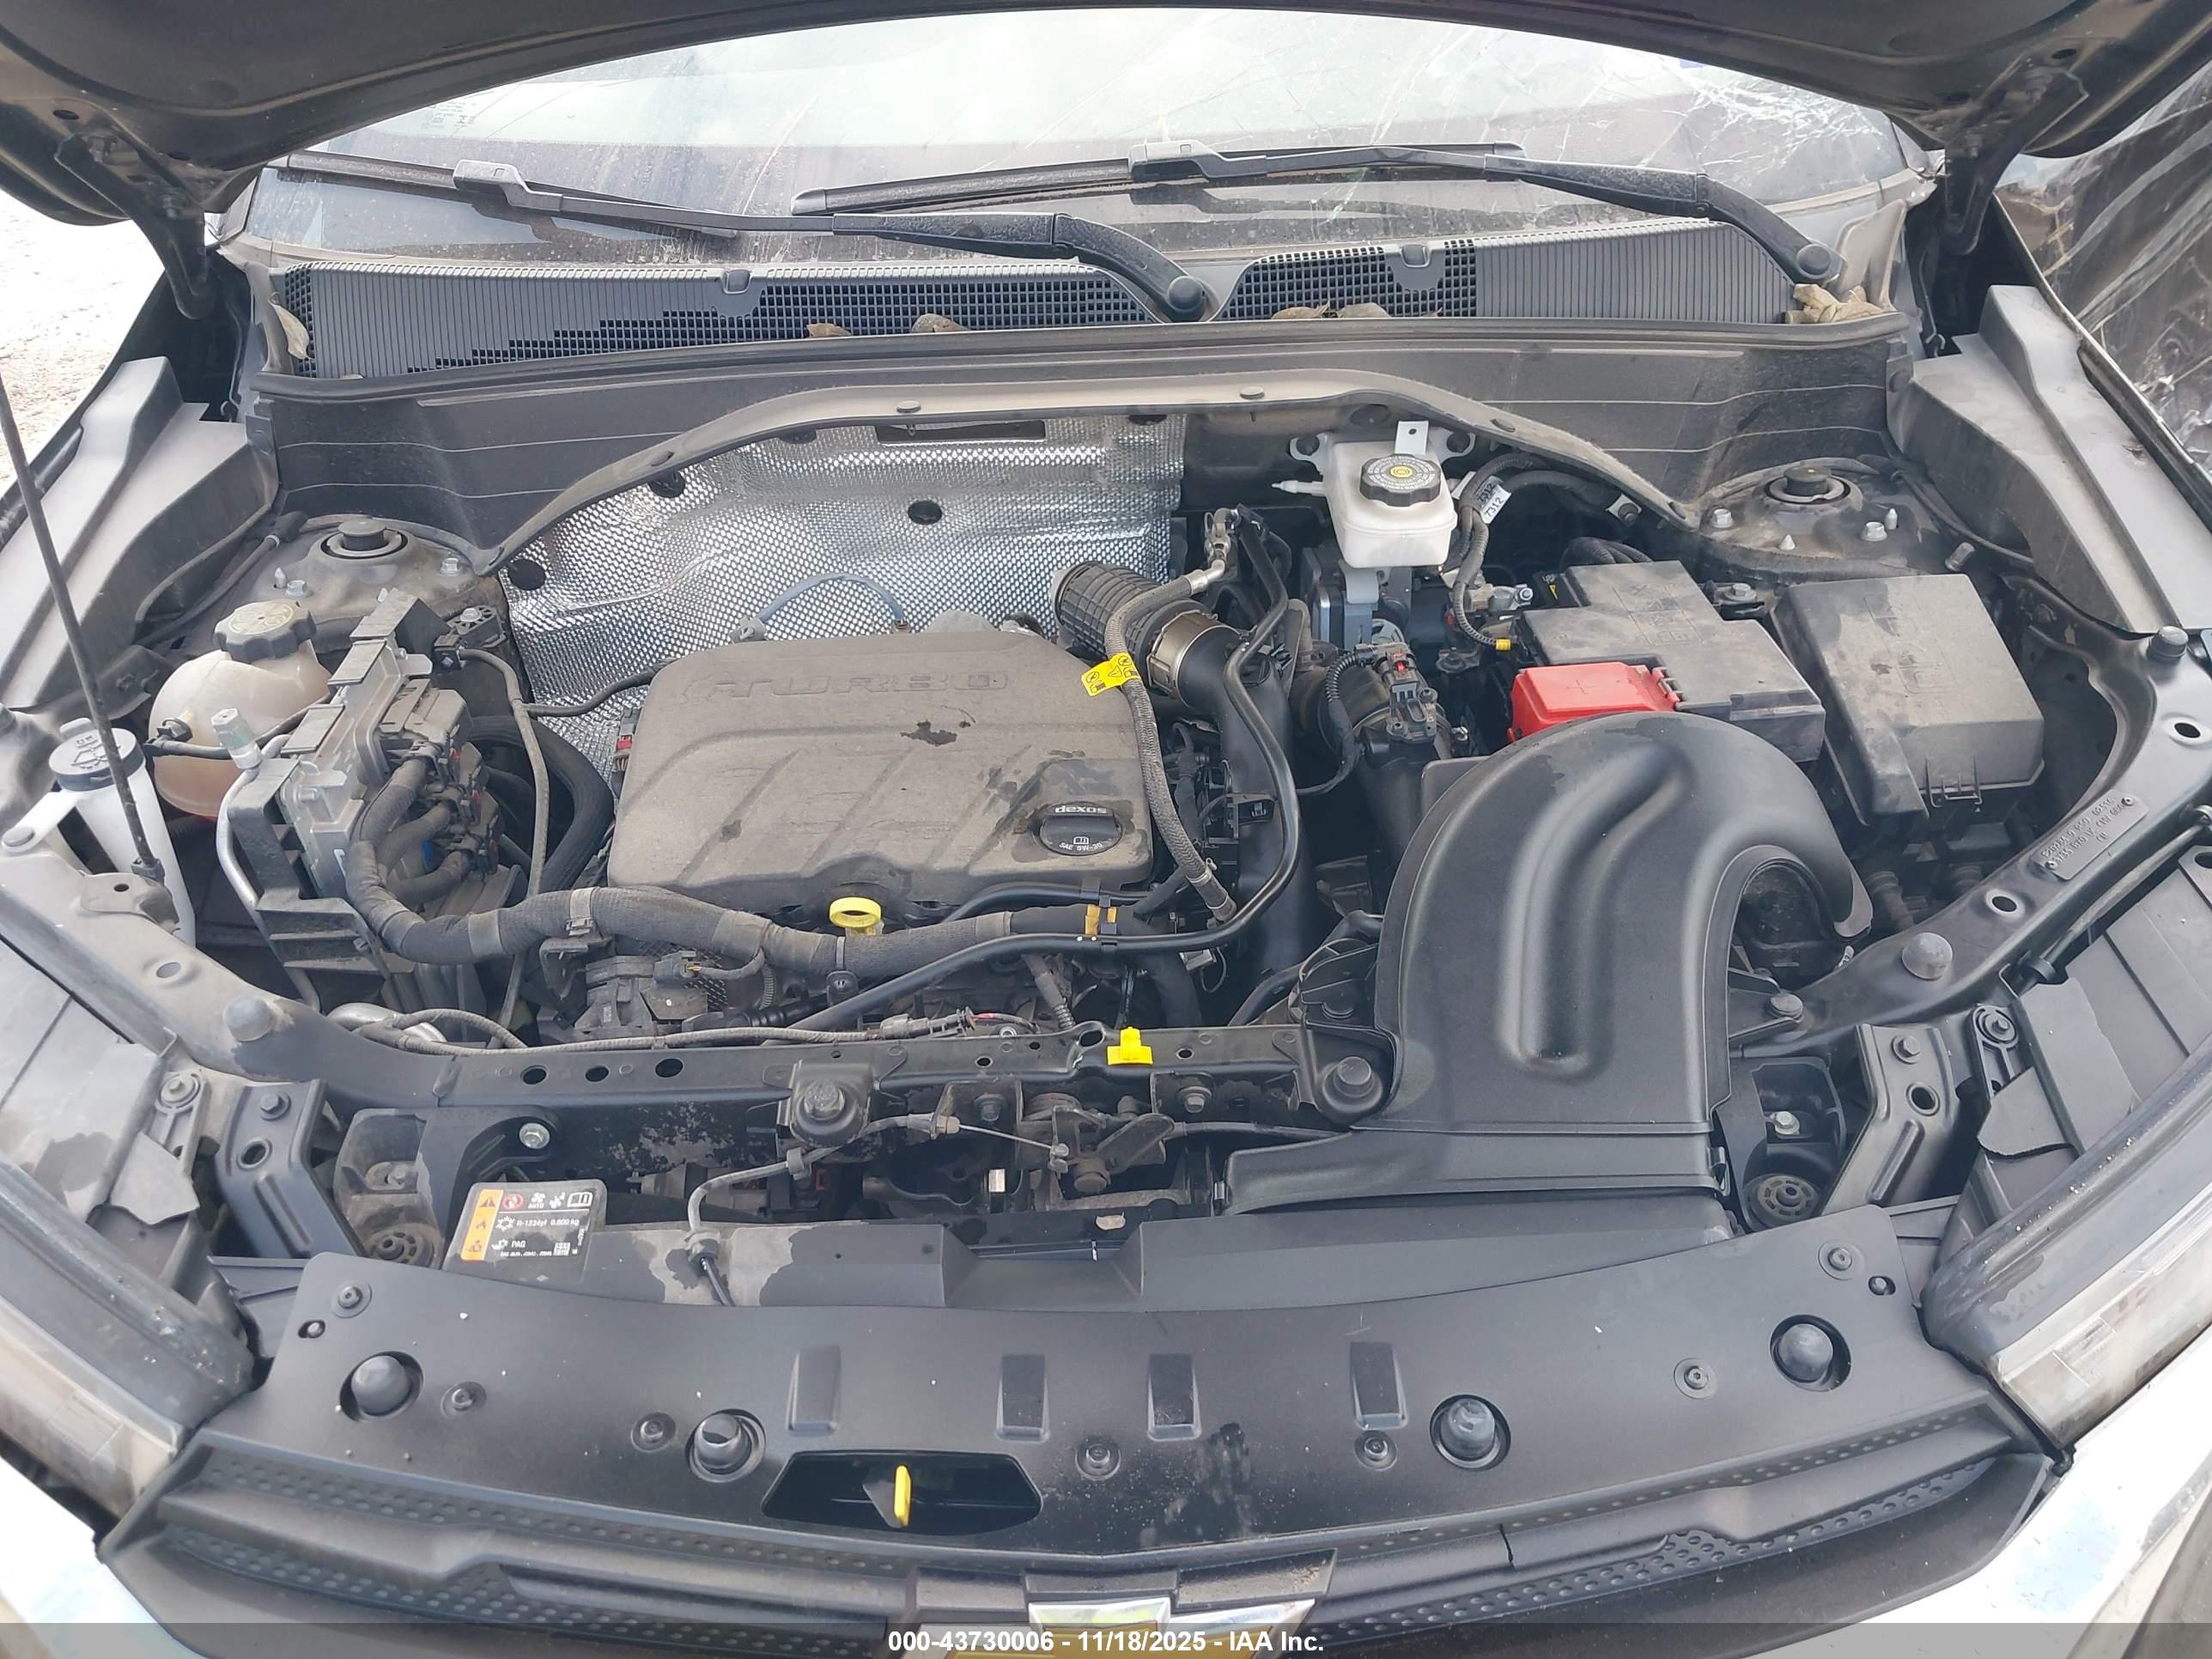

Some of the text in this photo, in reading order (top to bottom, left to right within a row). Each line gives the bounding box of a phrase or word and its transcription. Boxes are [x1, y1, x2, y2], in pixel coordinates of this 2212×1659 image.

[1484, 496, 1504, 517] T312
[716, 672, 1008, 699] TURBO
[1054, 805, 1107, 814] dexos
[1077, 842, 1103, 851] 5W-30
[511, 1240, 526, 1249] PAG
